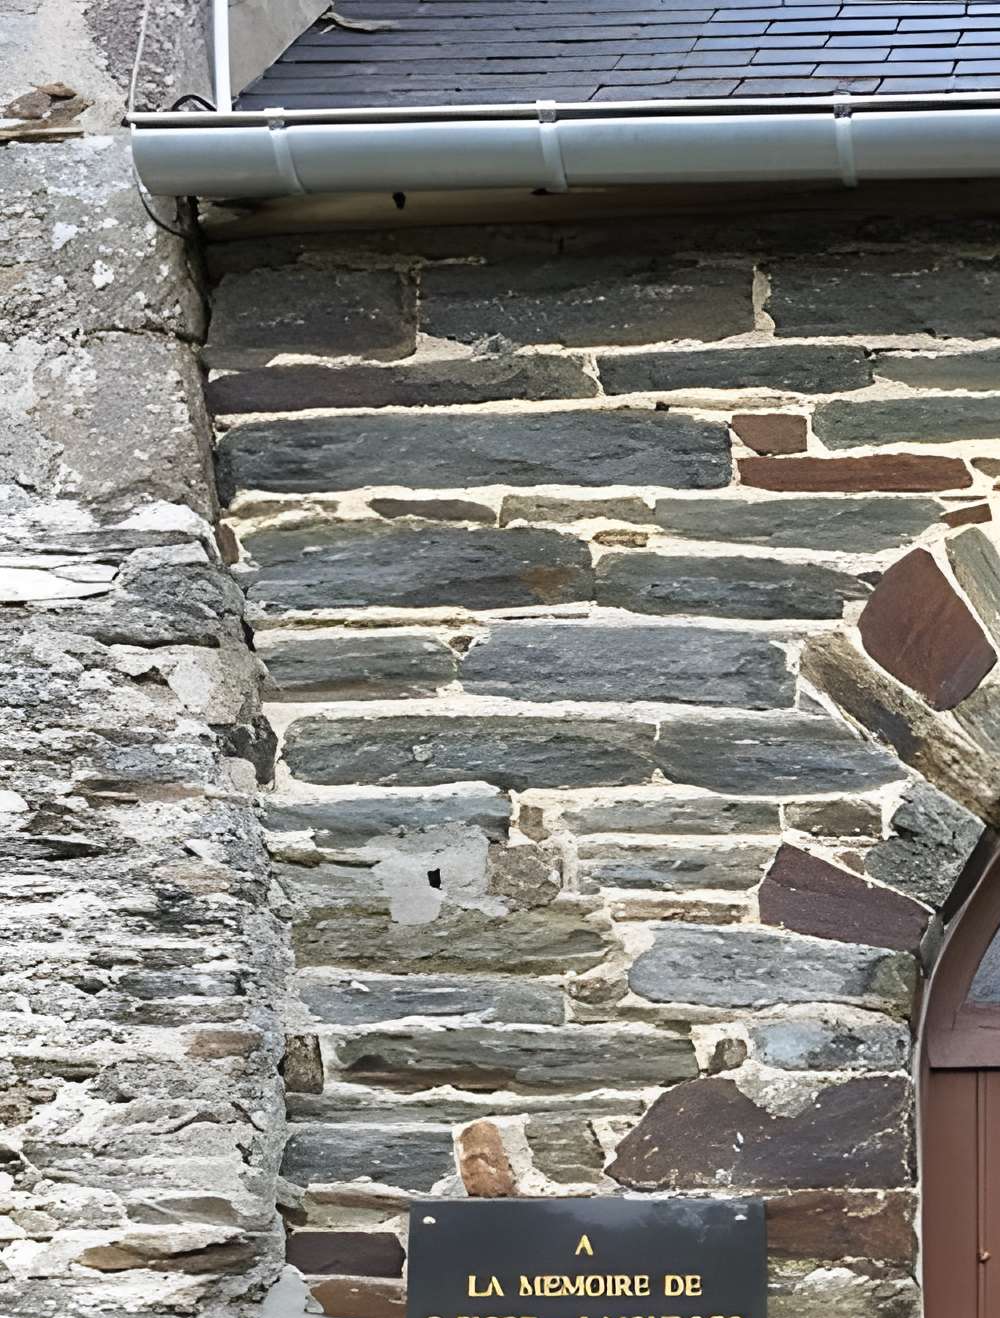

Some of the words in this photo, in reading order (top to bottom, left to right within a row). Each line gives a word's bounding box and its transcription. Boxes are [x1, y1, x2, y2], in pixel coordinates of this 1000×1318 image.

[575, 1234, 594, 1256] A
[468, 1275, 504, 1297] LA
[519, 1275, 650, 1297] MEMOIRE
[664, 1275, 702, 1297] DE
